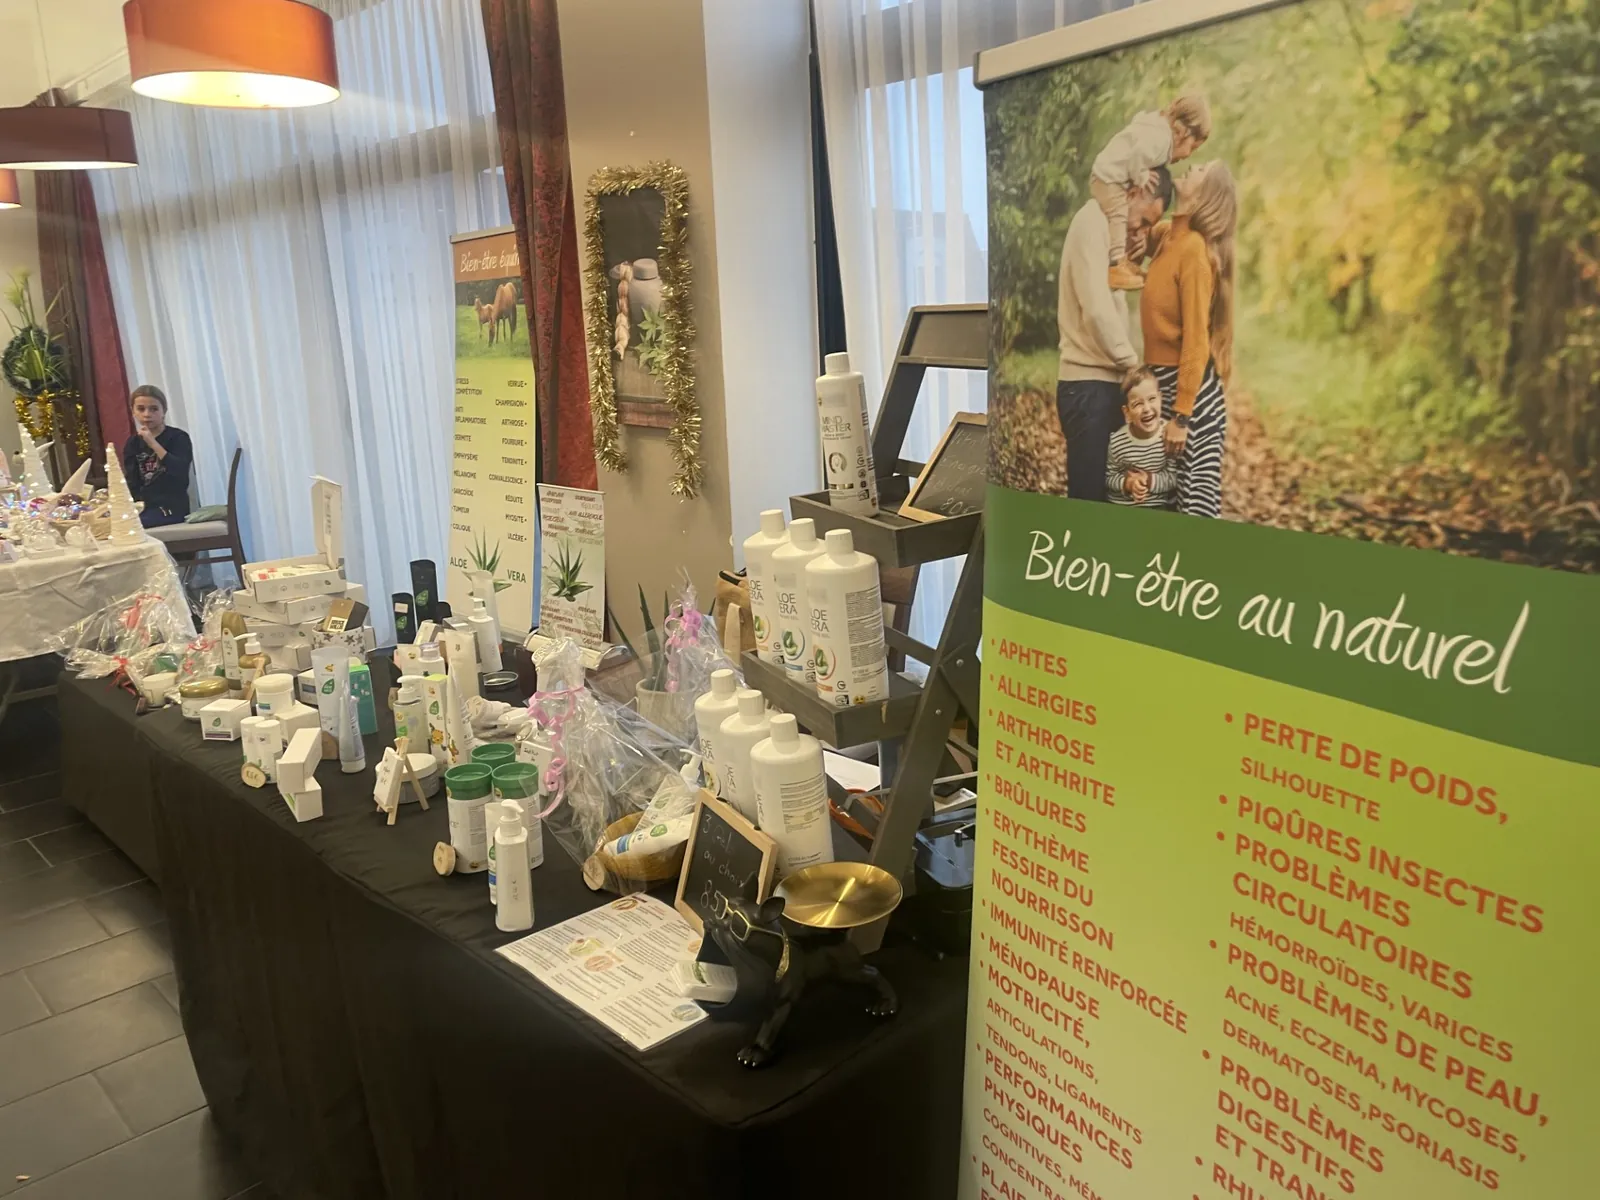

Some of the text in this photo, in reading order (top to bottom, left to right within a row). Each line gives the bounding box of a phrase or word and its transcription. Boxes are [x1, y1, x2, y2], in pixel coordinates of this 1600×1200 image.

[500, 244, 520, 276] équin
[450, 557, 467, 569] ALOE
[507, 569, 526, 583] VERA
[780, 603, 798, 615] ERA
[1024, 529, 1529, 694] Bien-être au naturel
[998, 638, 1068, 678] APHTES
[998, 674, 1097, 726] ALLERGIES
[995, 741, 1116, 807] ET ARTHRITE
[996, 710, 1096, 765] ARTHROSE
[1243, 713, 1509, 825] PERTE DE POIDS,
[994, 774, 1087, 833] BRÛLURES
[1240, 756, 1381, 822] SILHOUETTE
[992, 840, 1094, 907] FESSIER DU
[993, 808, 1090, 874] ERYTHÈME
[1235, 833, 1411, 928] PROBLÈMES
[1237, 795, 1544, 934] PIQÛRES INSECTES
[991, 868, 1114, 952] NOURRISSON
[1232, 871, 1473, 1000] CIRCULATOIRES
[988, 965, 1091, 1047] MOTRICITÉ,
[989, 934, 1099, 1020] MÉNOPAUSE
[990, 904, 1188, 1034] IMMUNITÉ RENFORCÉE
[1230, 911, 1513, 1063] HÉMORROÏDES, VARICES
[986, 997, 1098, 1084] ARTICULATIONS,
[1224, 984, 1526, 1162] ACNÉ, ECZEMA, MYCOSES,
[1227, 942, 1548, 1127] PROBLÈMES DE PEAU,
[984, 1076, 1083, 1163] PHYSIQUES
[985, 1050, 1133, 1169] PERFORMANCES
[986, 1022, 1143, 1145] TENDONS, LIGAMENTS
[1220, 1053, 1384, 1173] PROBLÈMES
[983, 1107, 1066, 1184] COGNITIVES,
[1216, 1123, 1330, 1200] ET TRAN
[1217, 1089, 1355, 1194] DIGESTIFS
